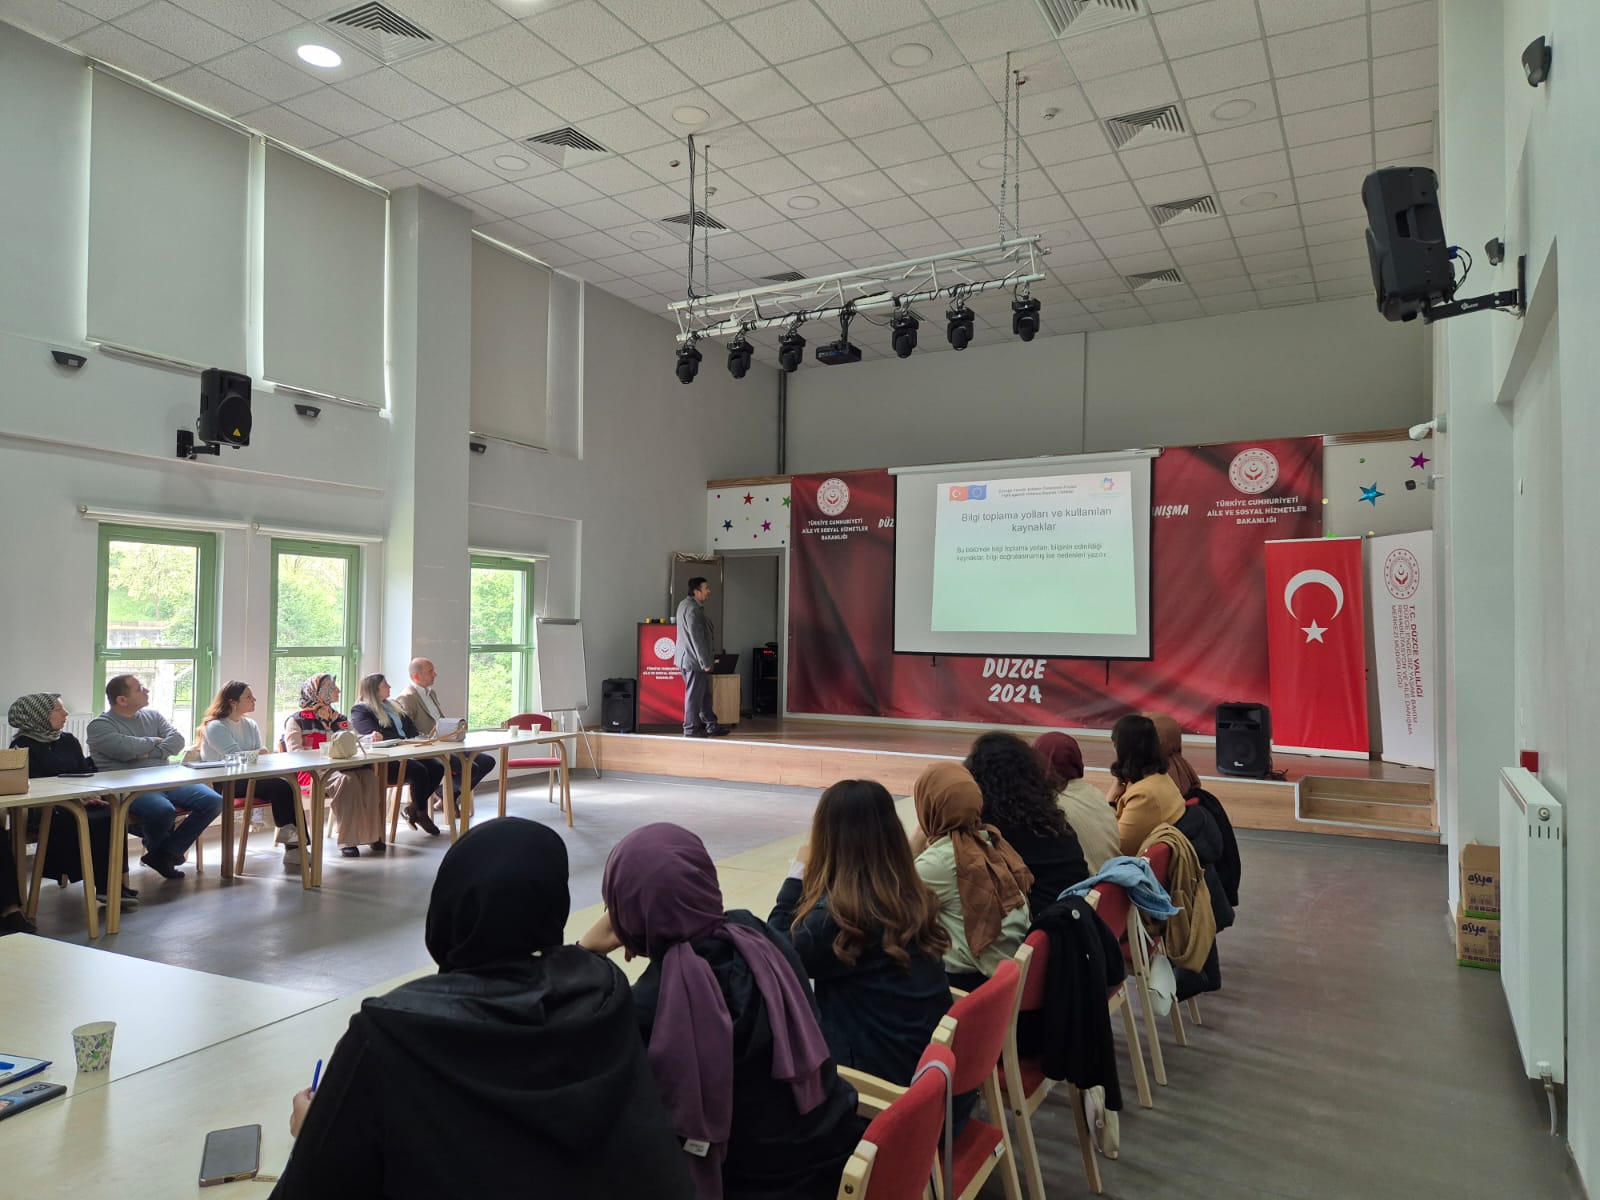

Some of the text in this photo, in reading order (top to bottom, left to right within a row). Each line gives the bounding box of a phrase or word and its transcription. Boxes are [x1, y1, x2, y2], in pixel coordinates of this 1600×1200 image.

[1216, 496, 1298, 507] TÜRKİYE CUMHURİYETİ
[961, 507, 1112, 523] Bilgi toplama yolları ve kullanılan
[1152, 504, 1189, 519] NIŞMA
[1265, 505, 1307, 514] HİZMETLER
[1236, 516, 1277, 525] BAKANLIĞI
[1012, 523, 1057, 533] kaynaklar
[1411, 623, 1419, 656] DÜZCE
[1414, 658, 1424, 698] VALİLİĞİ
[988, 683, 1043, 704] 2024
[1468, 873, 1493, 886] asya
[1461, 923, 1487, 936] asya
